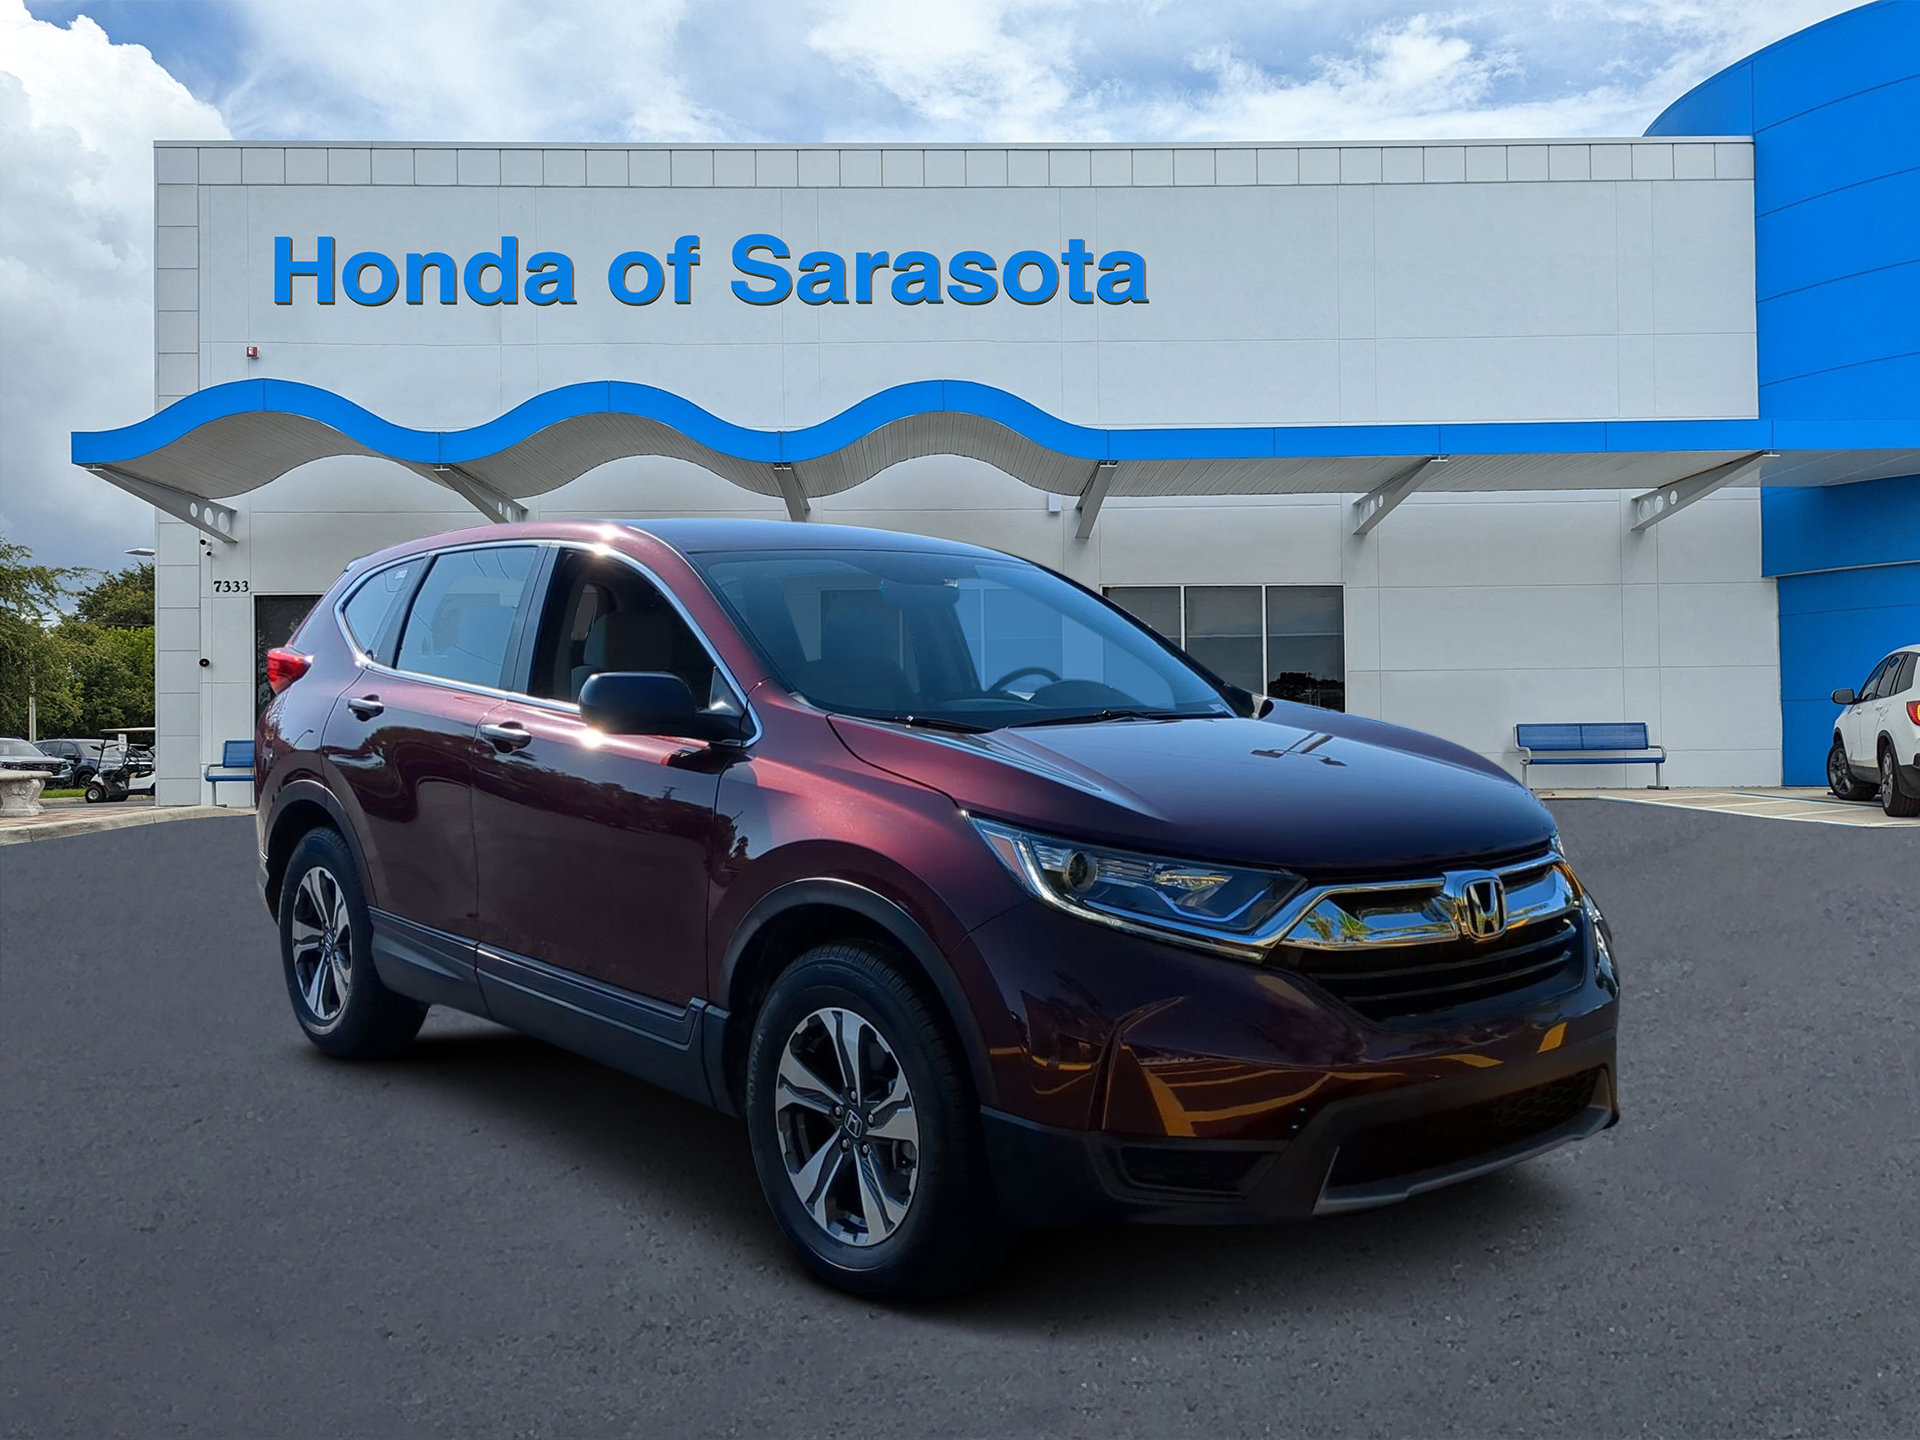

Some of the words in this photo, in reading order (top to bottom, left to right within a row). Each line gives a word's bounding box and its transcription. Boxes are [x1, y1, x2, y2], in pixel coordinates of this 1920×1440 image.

[273, 235, 577, 306] Honda
[608, 234, 700, 306] of
[731, 233, 1150, 306] Sarasota
[213, 580, 249, 593] 7333
